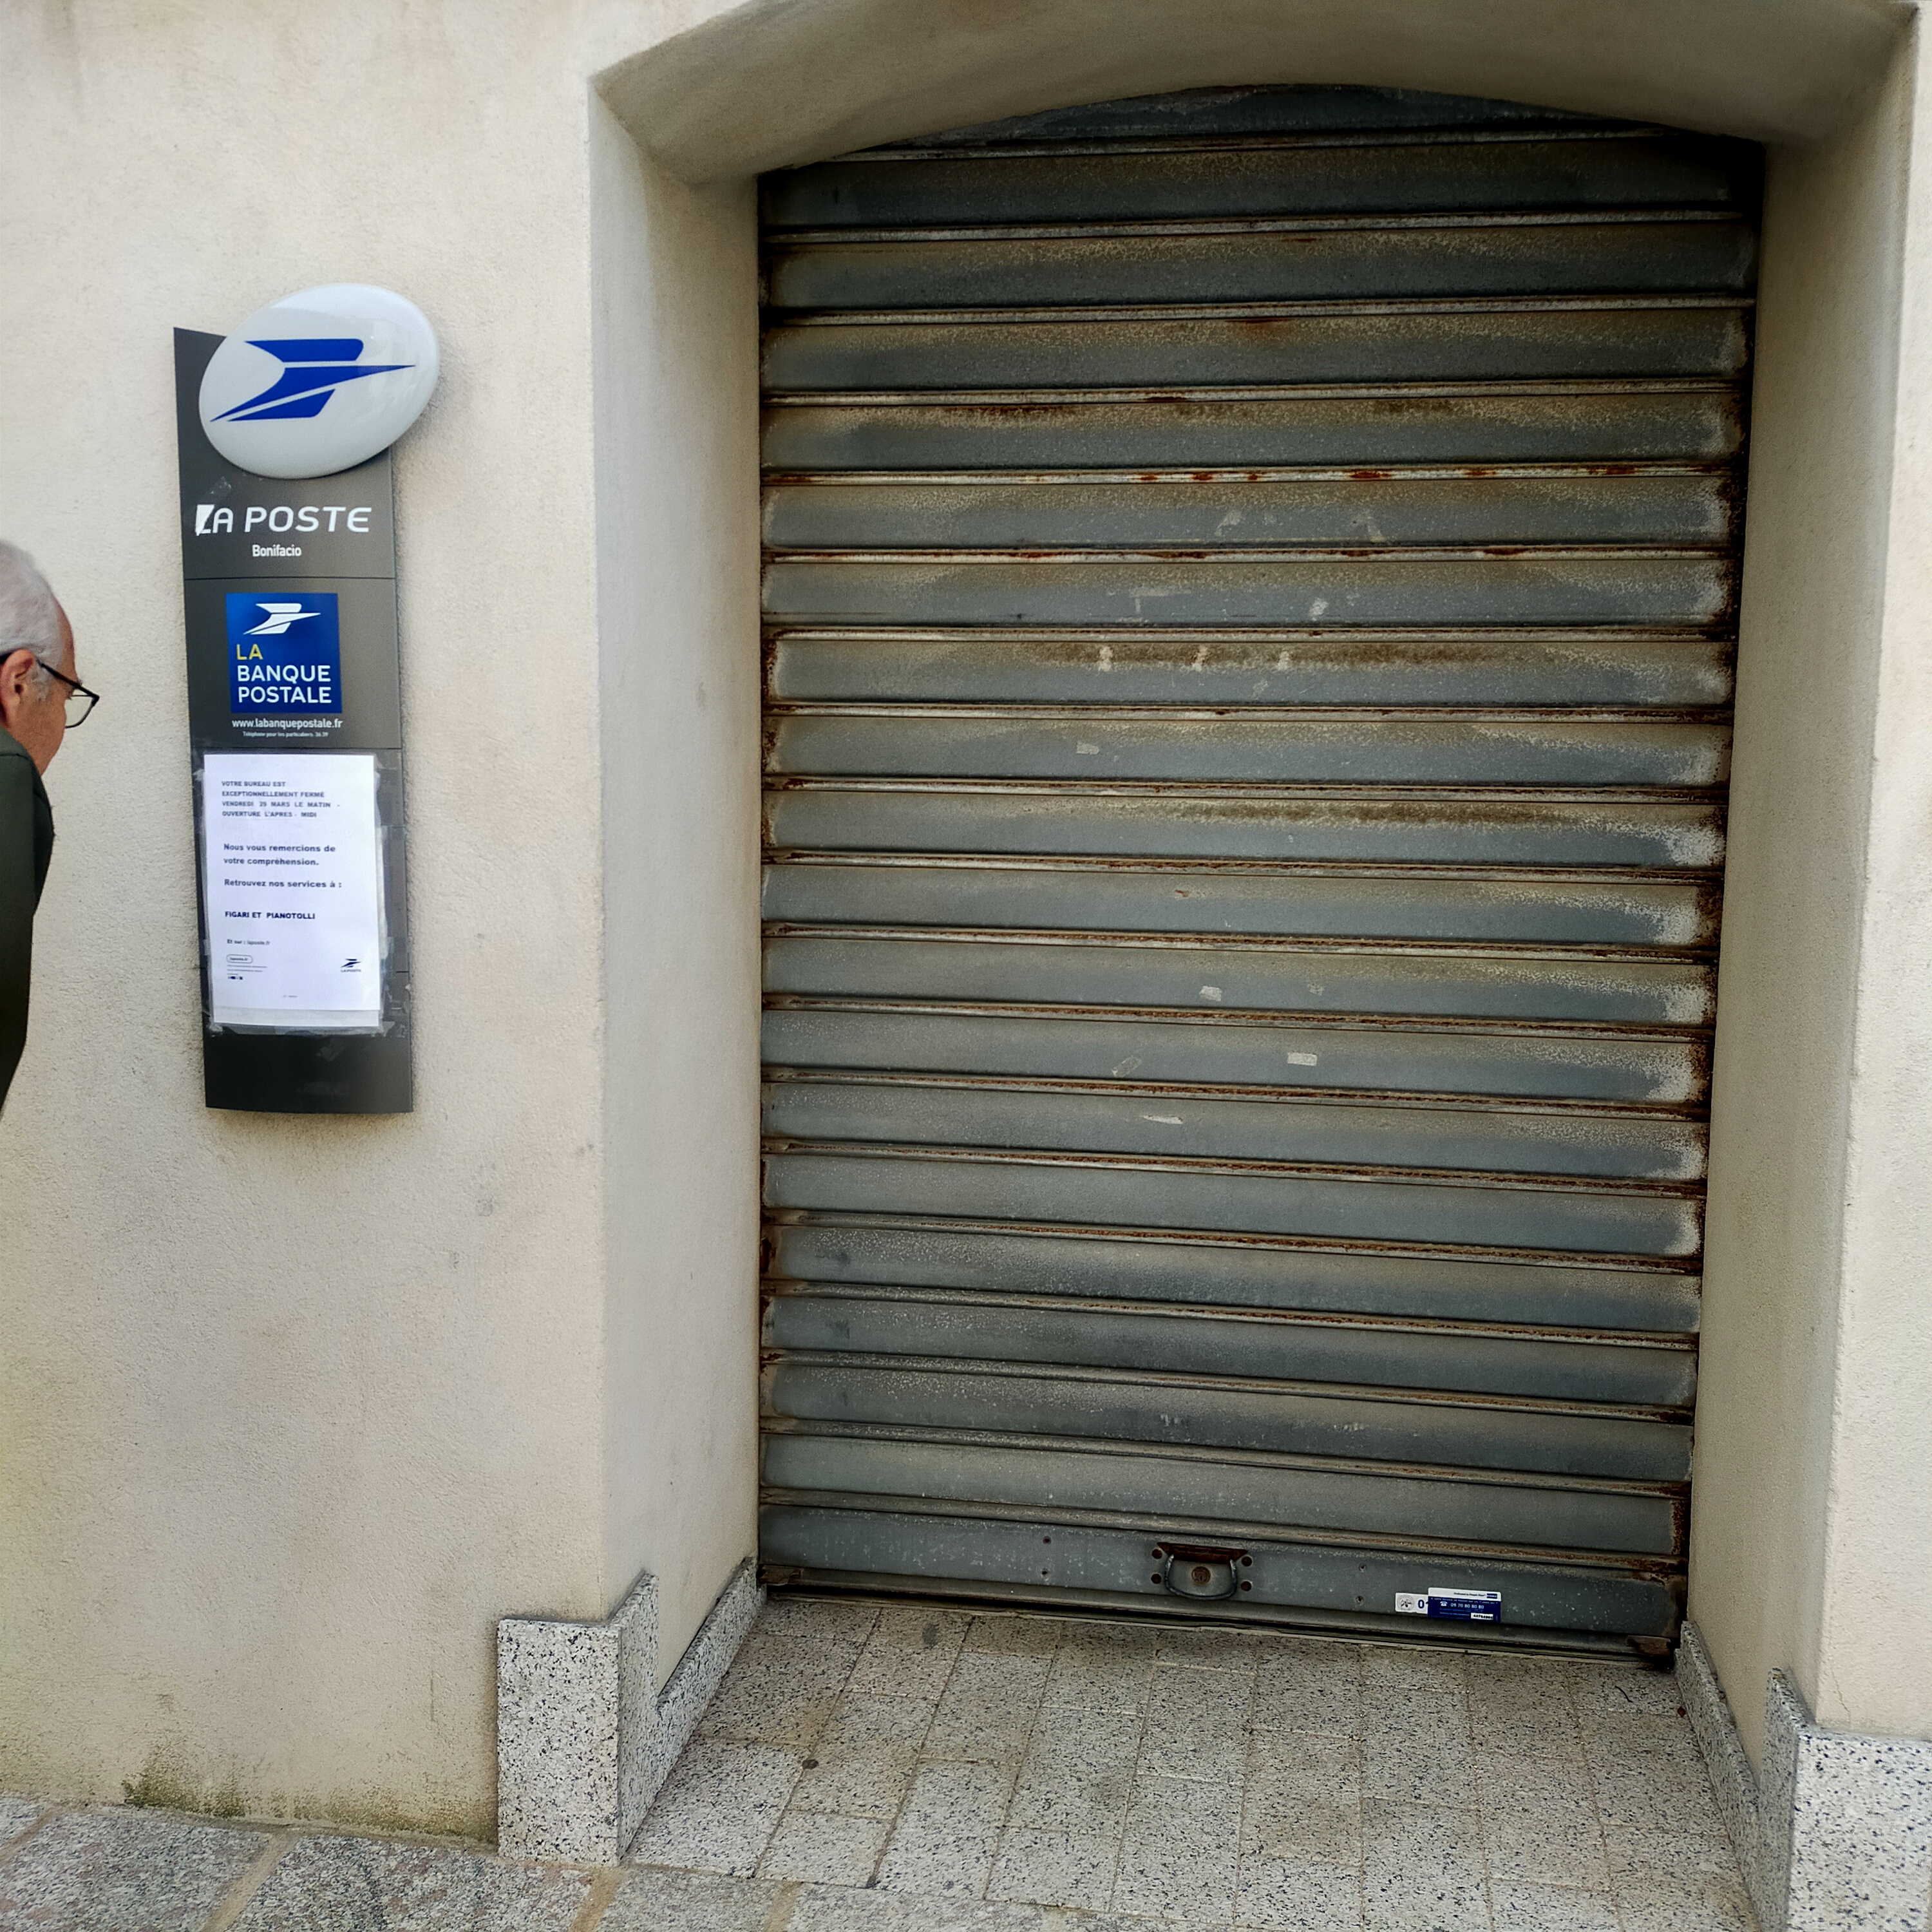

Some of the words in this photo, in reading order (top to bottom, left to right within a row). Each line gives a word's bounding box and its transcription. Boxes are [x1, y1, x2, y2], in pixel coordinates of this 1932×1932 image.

[195, 504, 233, 536] LA
[245, 506, 372, 533] POSTE
[252, 544, 301, 556] Bonifacio
[237, 644, 263, 659] LA
[238, 665, 331, 684] BANQUE
[238, 687, 332, 703] POSTALE
[232, 718, 343, 730] www.labanquepostale.fr
